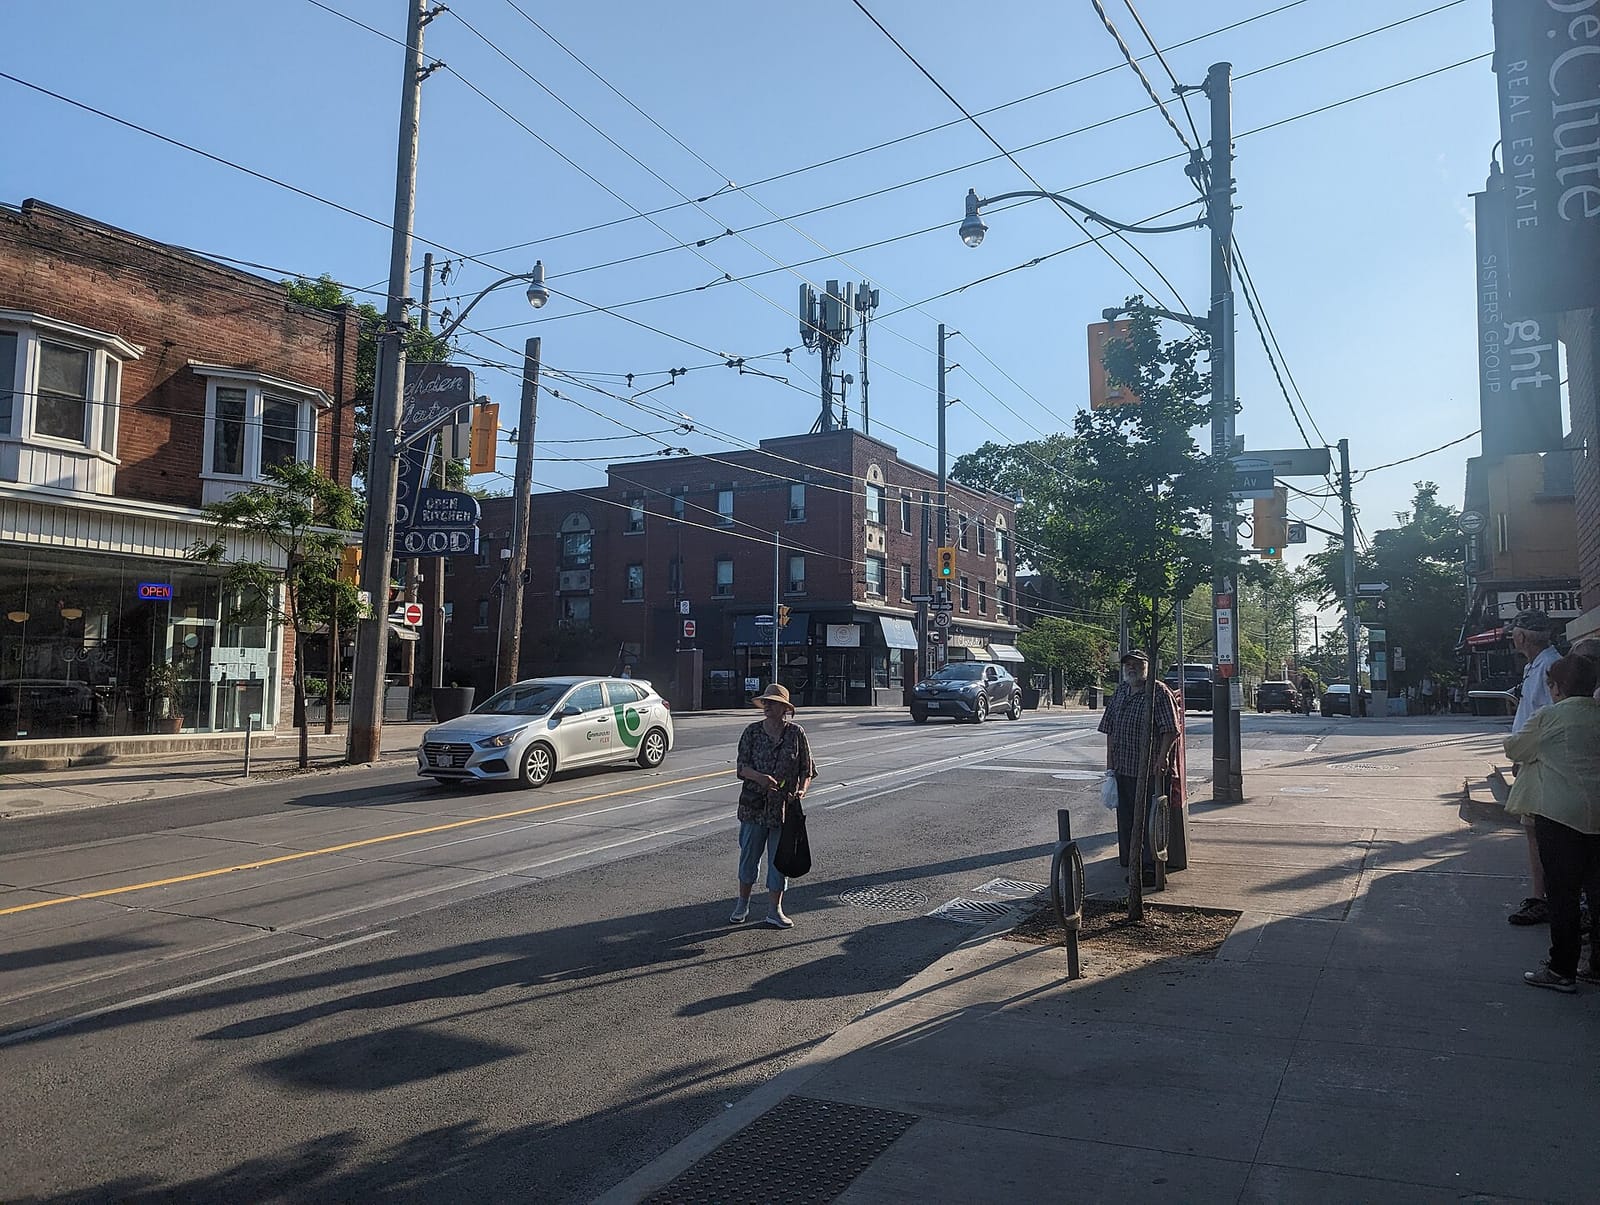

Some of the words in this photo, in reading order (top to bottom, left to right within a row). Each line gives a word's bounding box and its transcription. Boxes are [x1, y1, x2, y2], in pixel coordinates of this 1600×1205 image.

[1507, 60, 1531, 123] REAL
[1546, 0, 1600, 221] e.Clute
[1512, 136, 1539, 229] ESTATE
[1482, 254, 1499, 324] SISTERS
[403, 373, 464, 397] arden
[1484, 330, 1501, 393] GROUP
[1503, 319, 1553, 391] ght
[1243, 477, 1257, 487] Av
[422, 509, 471, 522] KITCHEN
[141, 586, 170, 597] OPEN
